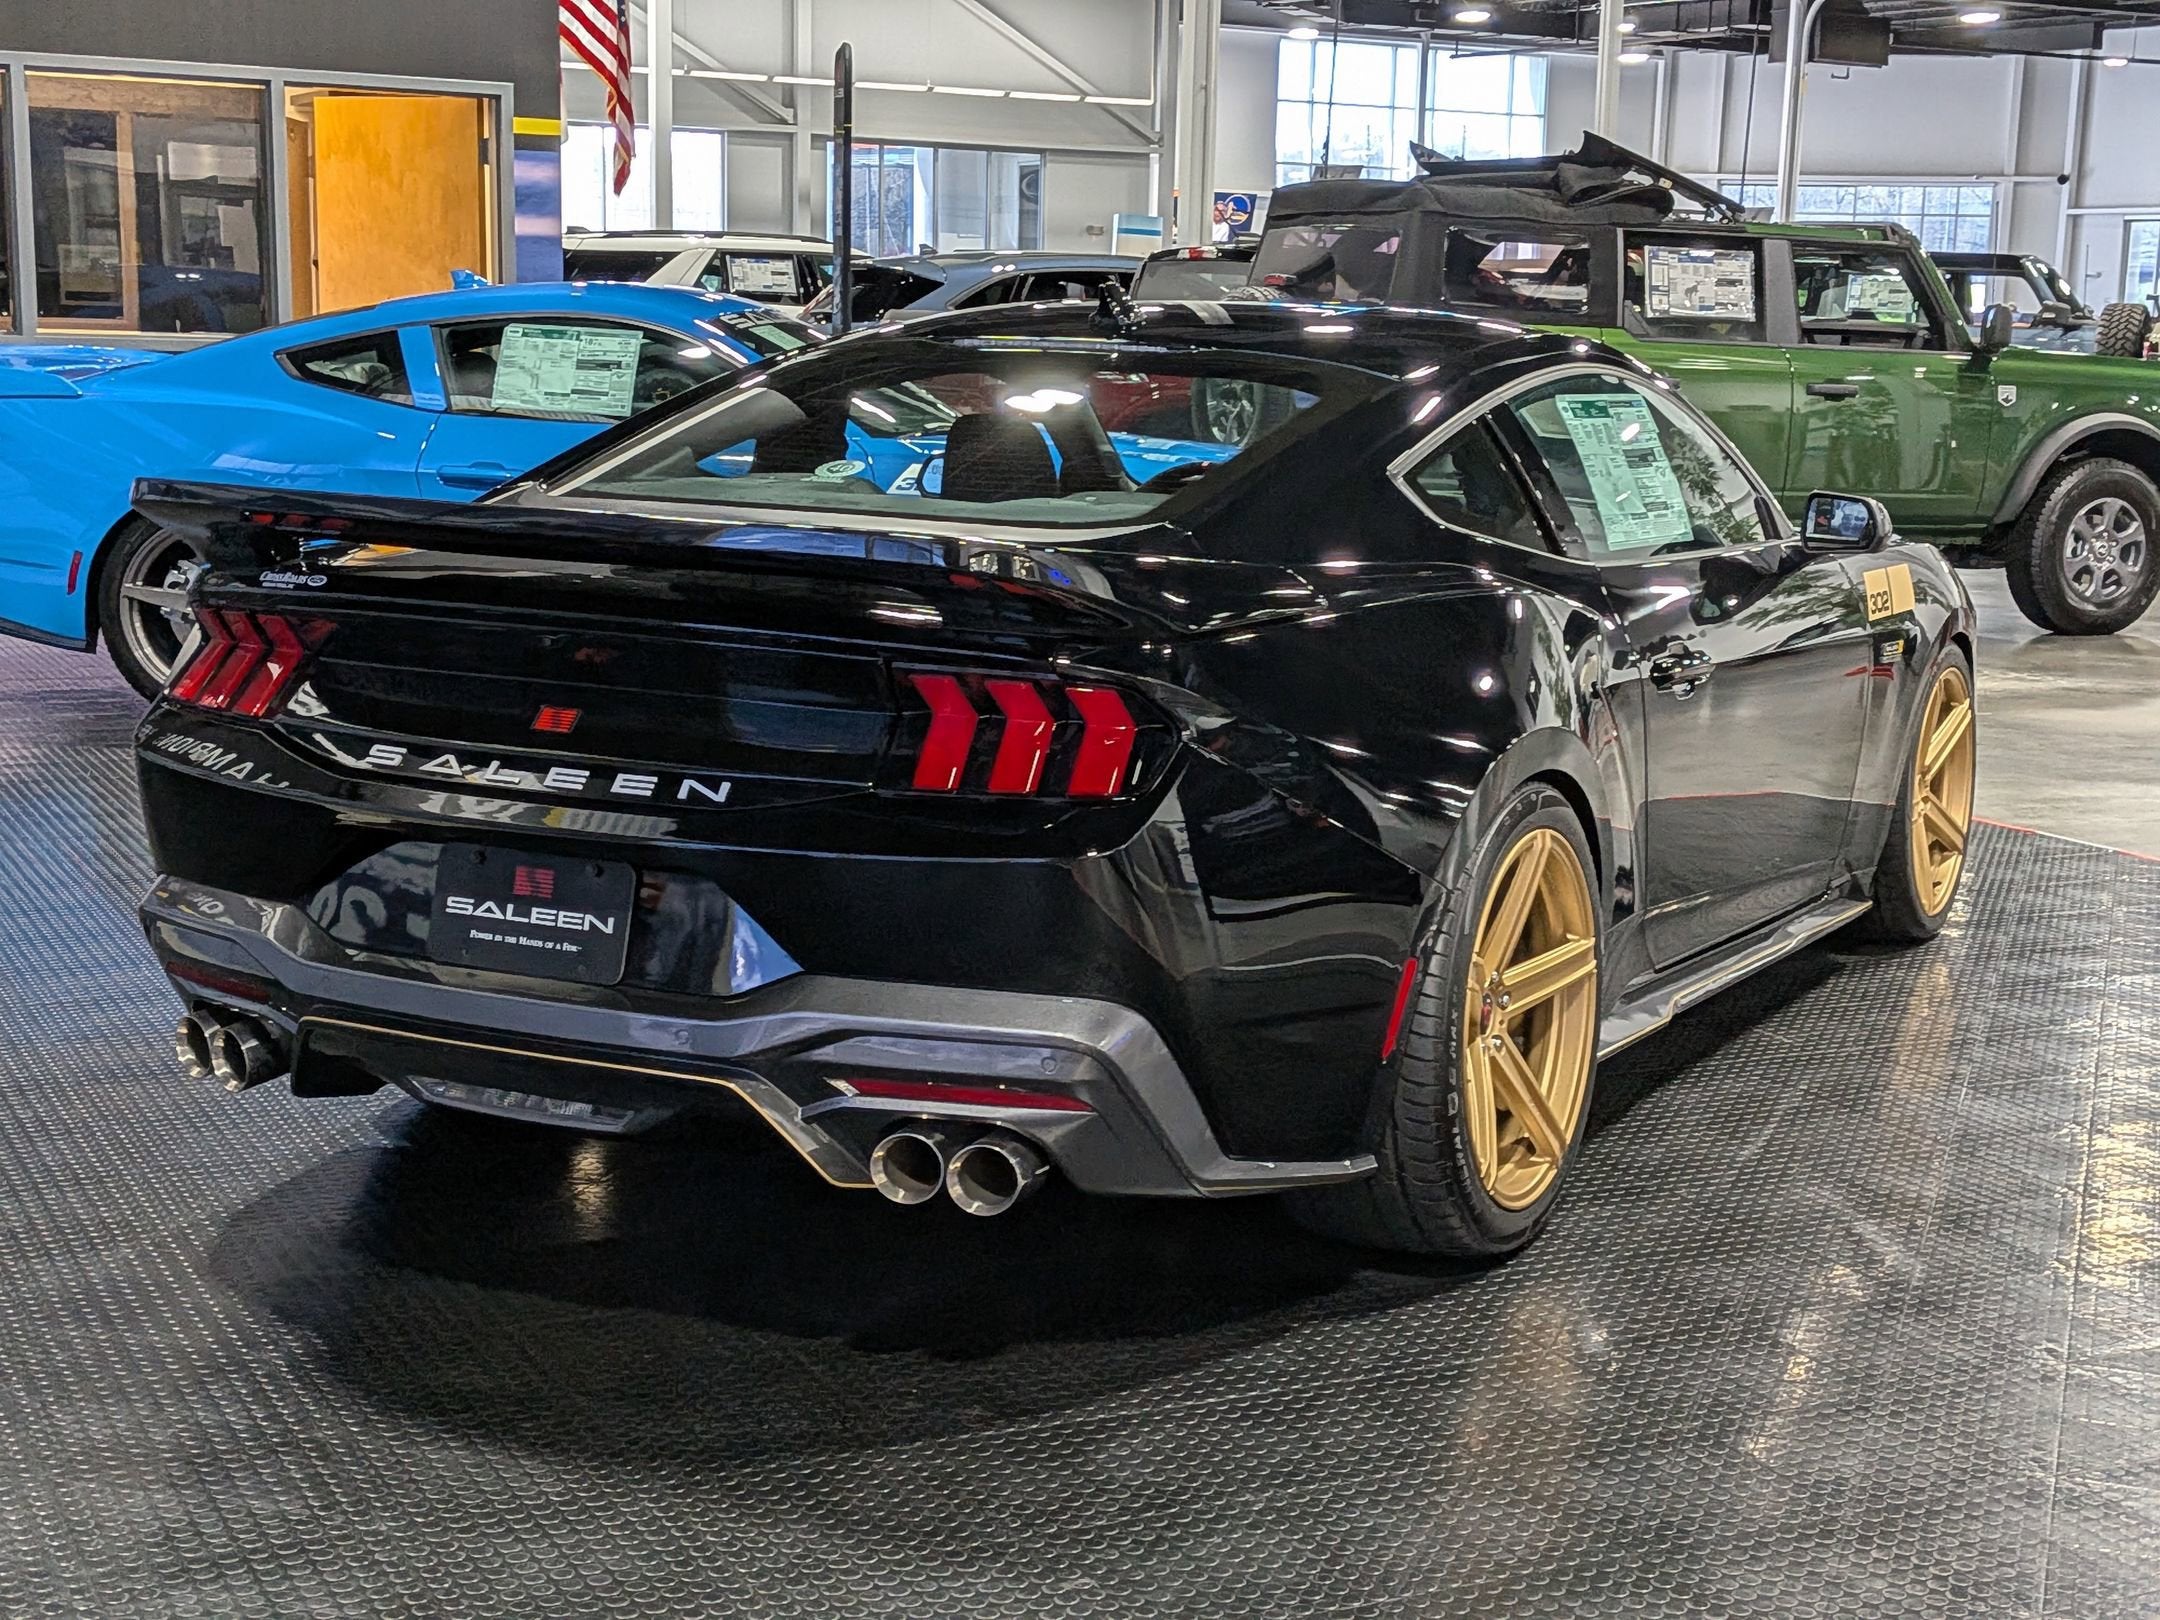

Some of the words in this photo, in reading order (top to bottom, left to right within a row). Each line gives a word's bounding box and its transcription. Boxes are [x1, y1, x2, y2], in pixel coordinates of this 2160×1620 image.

[1869, 590, 1889, 614] 302
[364, 743, 732, 803] SALEEN
[445, 895, 615, 935] SALEEN
